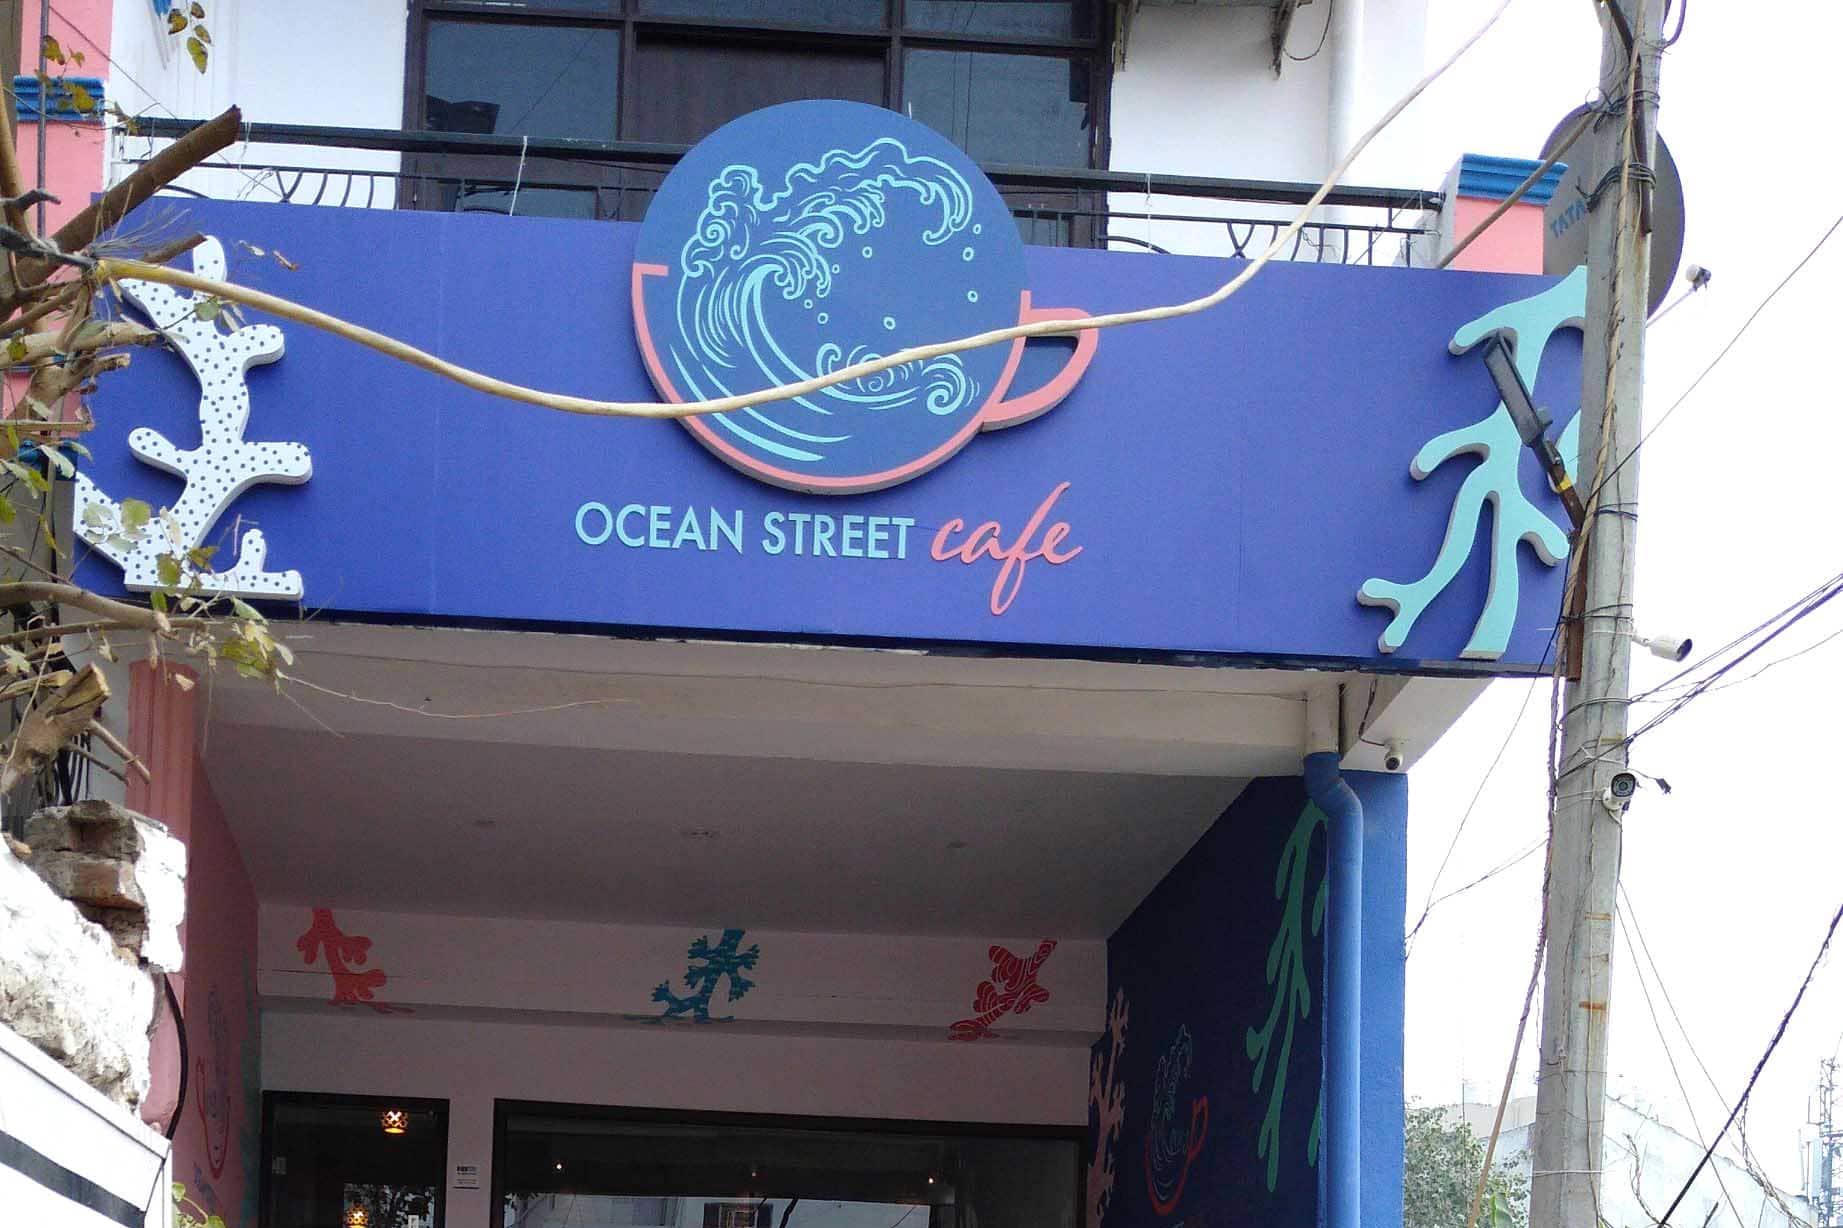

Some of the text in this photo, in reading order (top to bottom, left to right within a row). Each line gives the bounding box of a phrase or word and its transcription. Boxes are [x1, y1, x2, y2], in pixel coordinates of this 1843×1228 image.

[575, 482, 1083, 616] OCEAN STREET cafe
